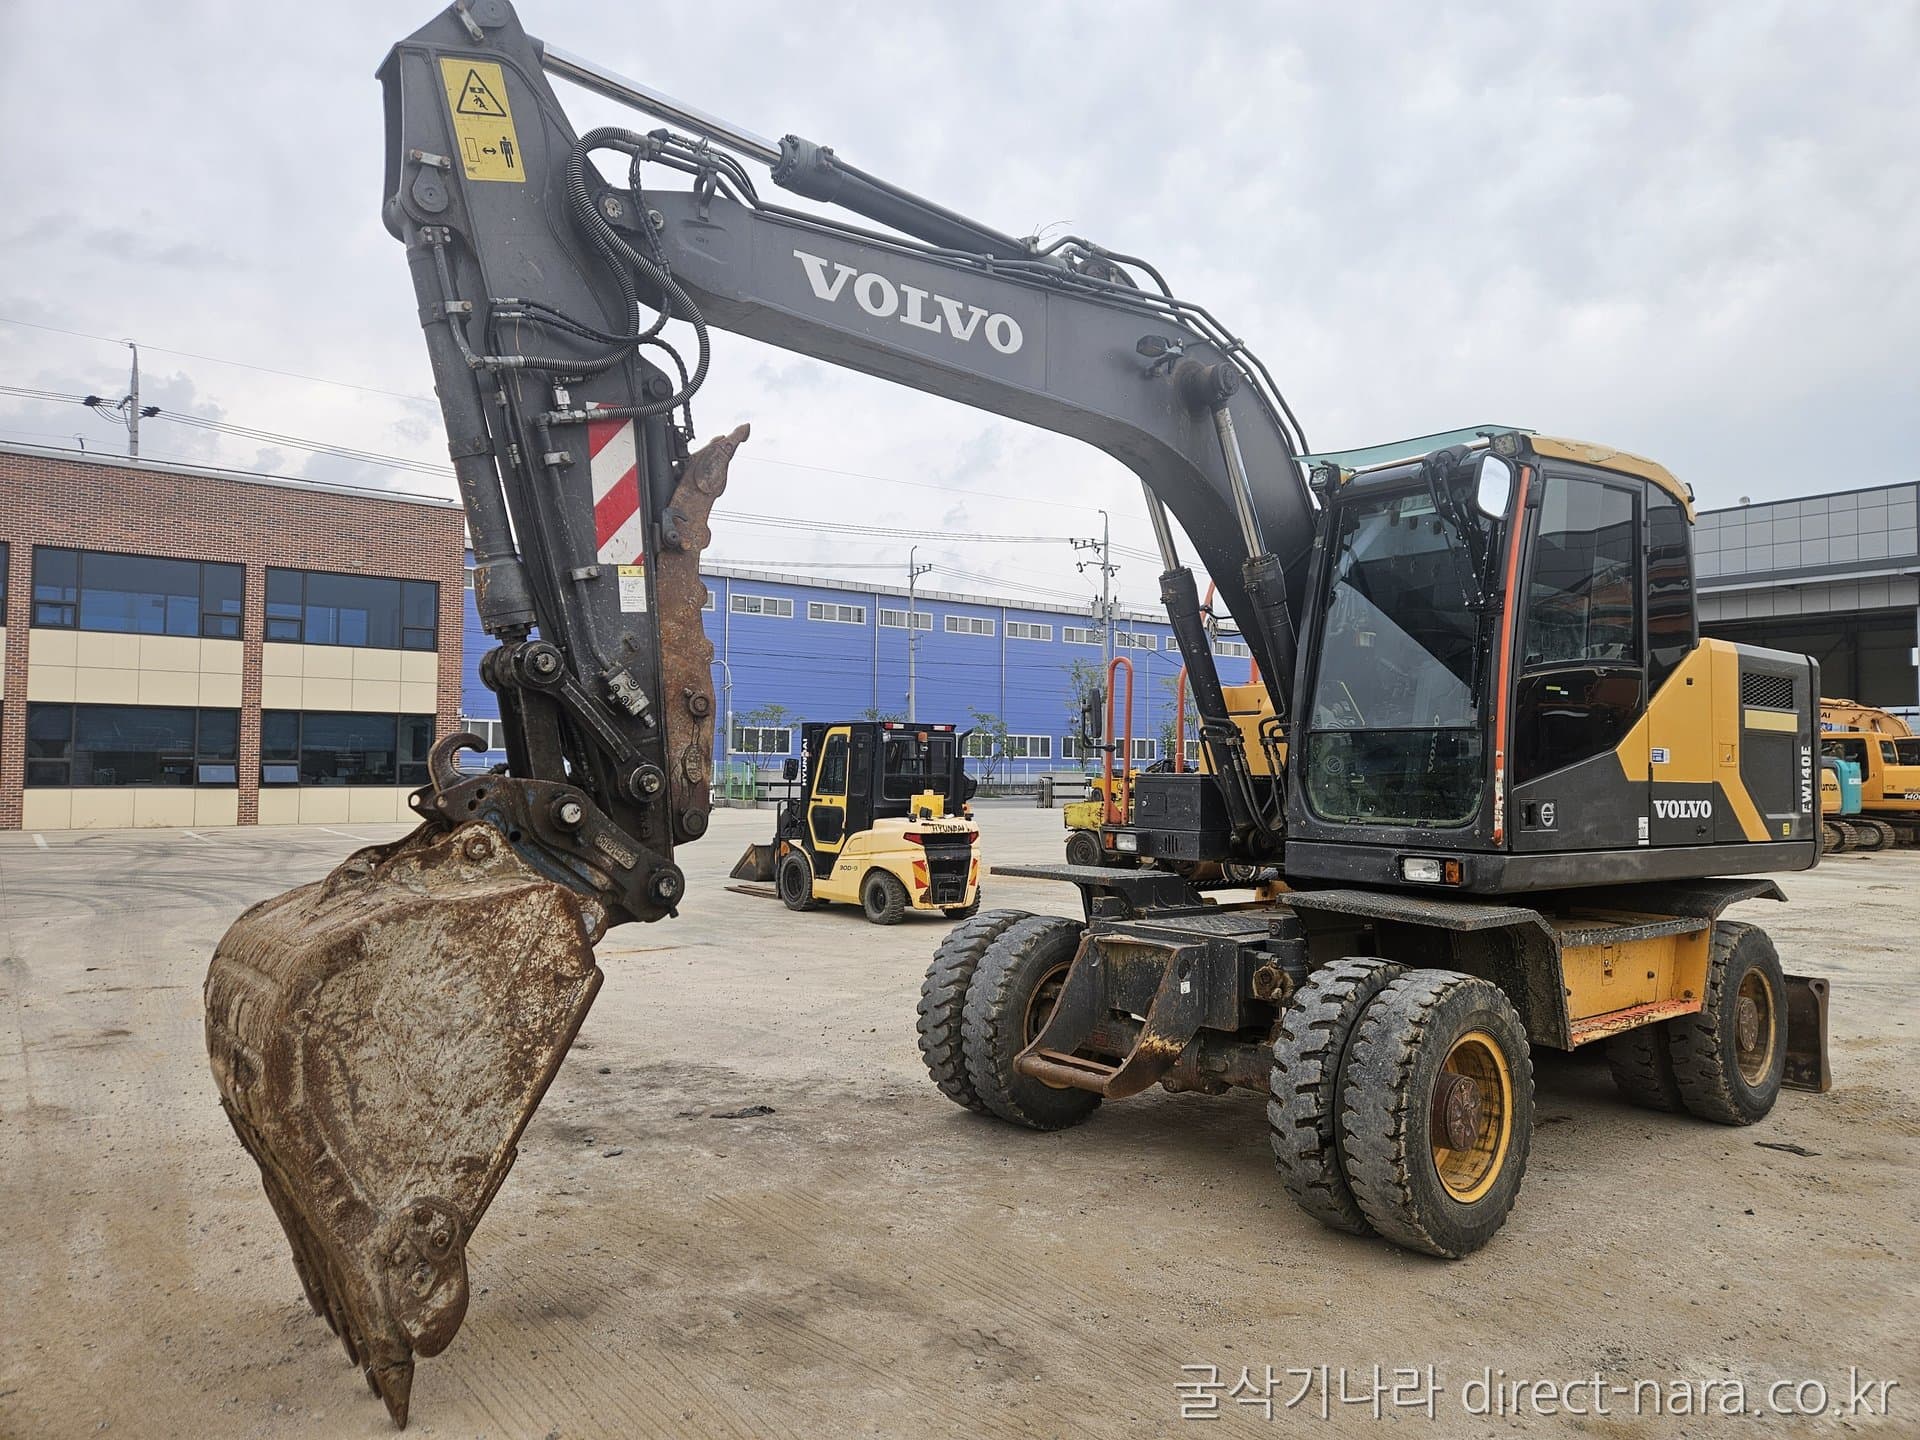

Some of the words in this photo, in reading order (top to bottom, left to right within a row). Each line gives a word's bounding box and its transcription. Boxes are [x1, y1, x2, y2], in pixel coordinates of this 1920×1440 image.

[793, 250, 1024, 354] VOLVO
[1653, 799, 1712, 819] VOLVO
[1801, 745, 1812, 813] EW140E
